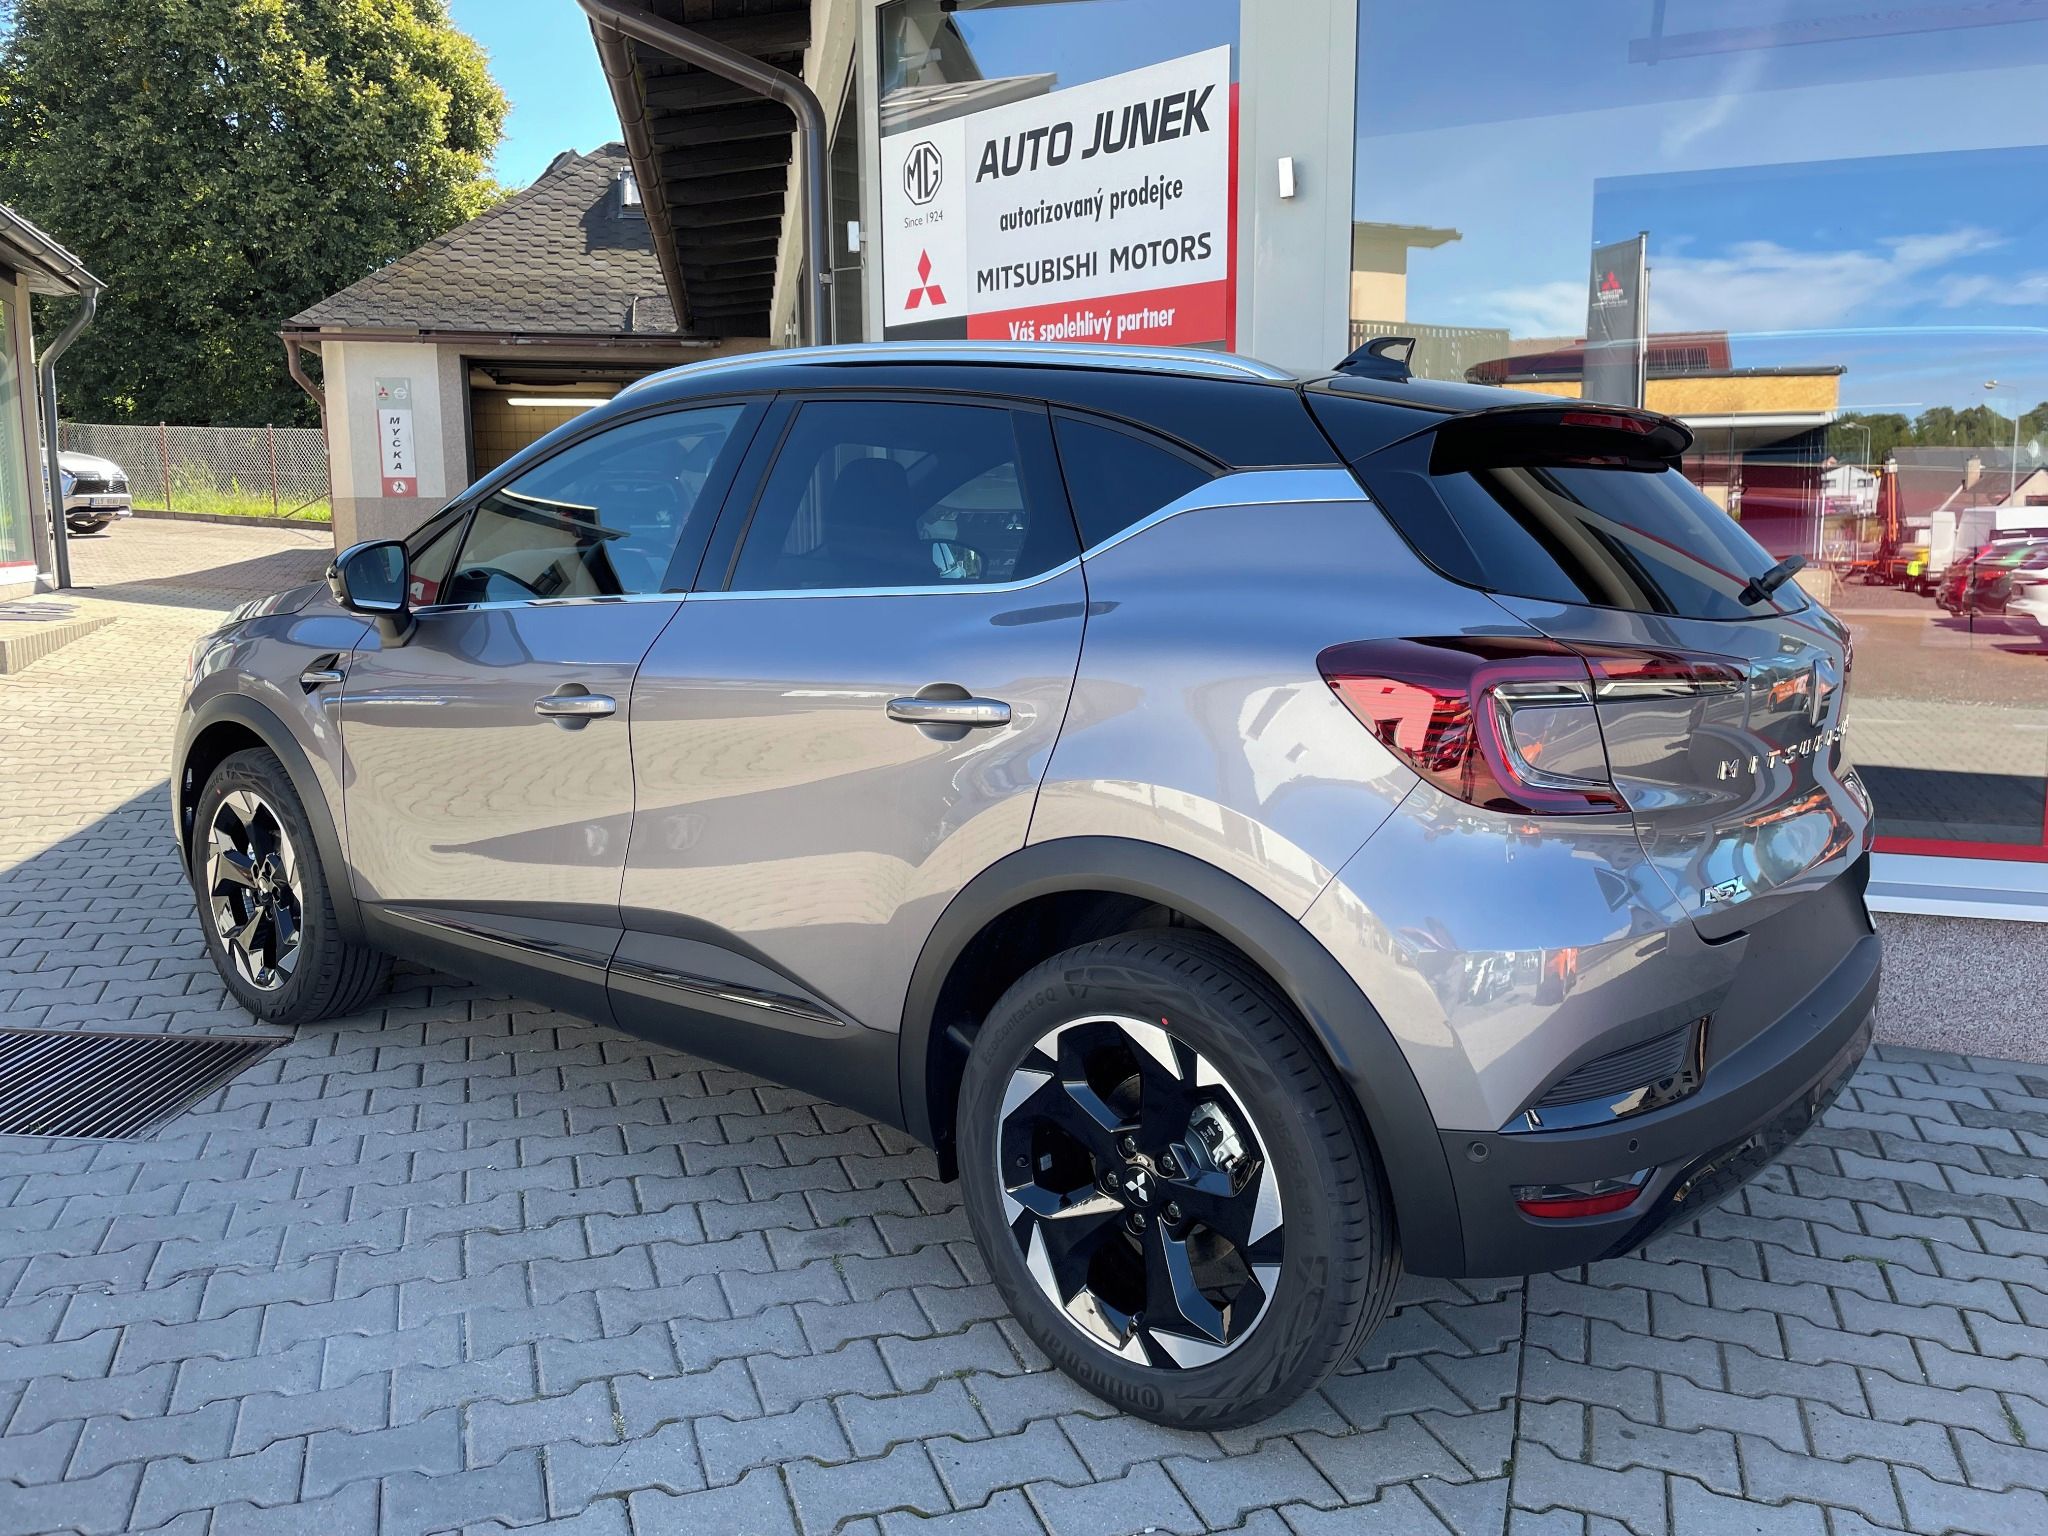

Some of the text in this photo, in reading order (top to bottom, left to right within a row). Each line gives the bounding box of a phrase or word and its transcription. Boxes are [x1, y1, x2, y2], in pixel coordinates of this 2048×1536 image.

[975, 84, 1216, 183] AUTO JUNEK
[906, 146, 940, 201] MG
[904, 210, 944, 229] Since 1924
[1000, 175, 1183, 232] autorizovaný prodejce
[977, 232, 1212, 294] MITSUBISHI MOTORS
[1008, 307, 1176, 342] Váš spolehlivý partner
[1701, 875, 1748, 908] ASX
[1040, 1328, 1165, 1413] Continental
